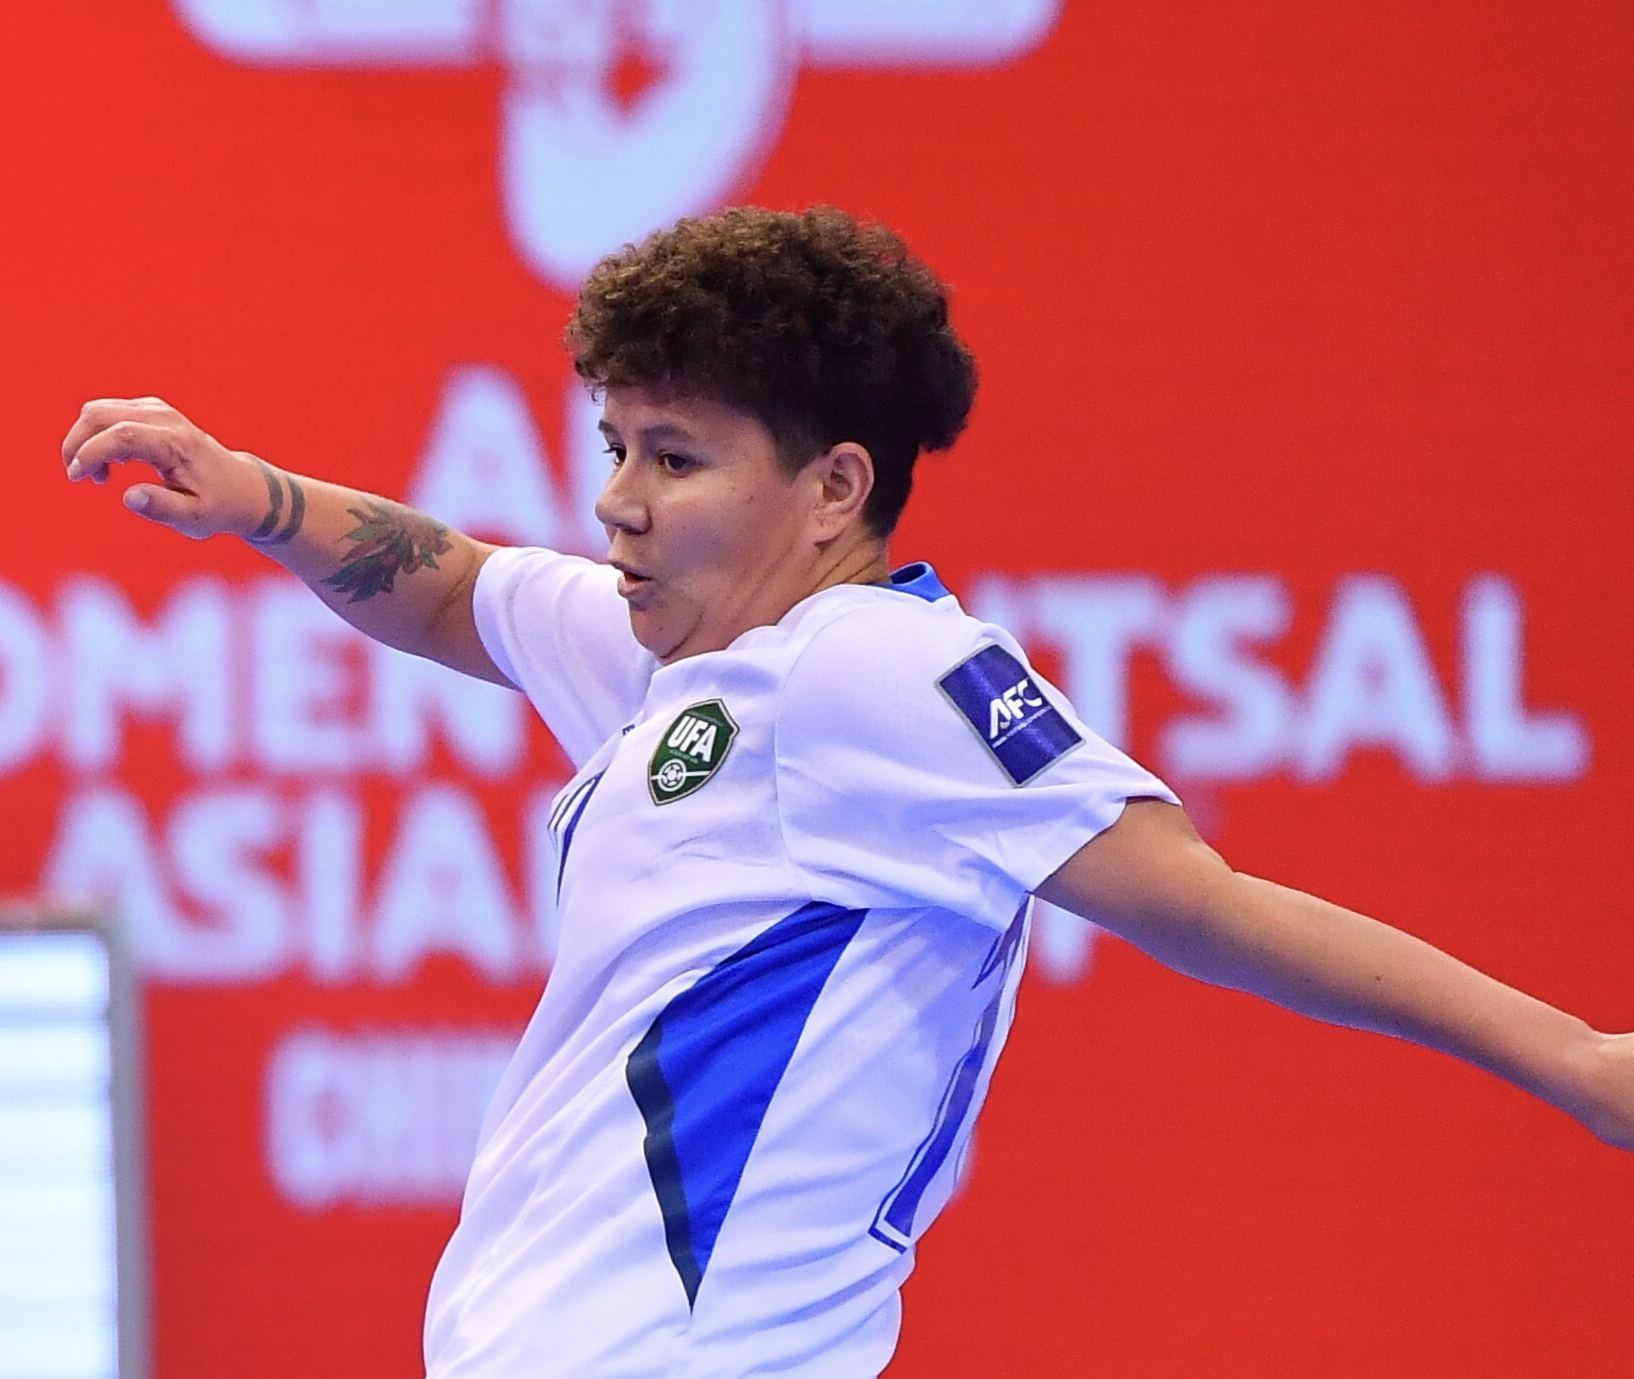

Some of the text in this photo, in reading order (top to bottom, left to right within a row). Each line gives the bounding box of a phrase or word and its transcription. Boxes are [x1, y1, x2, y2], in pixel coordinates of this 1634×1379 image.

[667, 715, 718, 763] UFA
[989, 678, 1043, 740] AFC
[41, 783, 559, 985] ASIA
